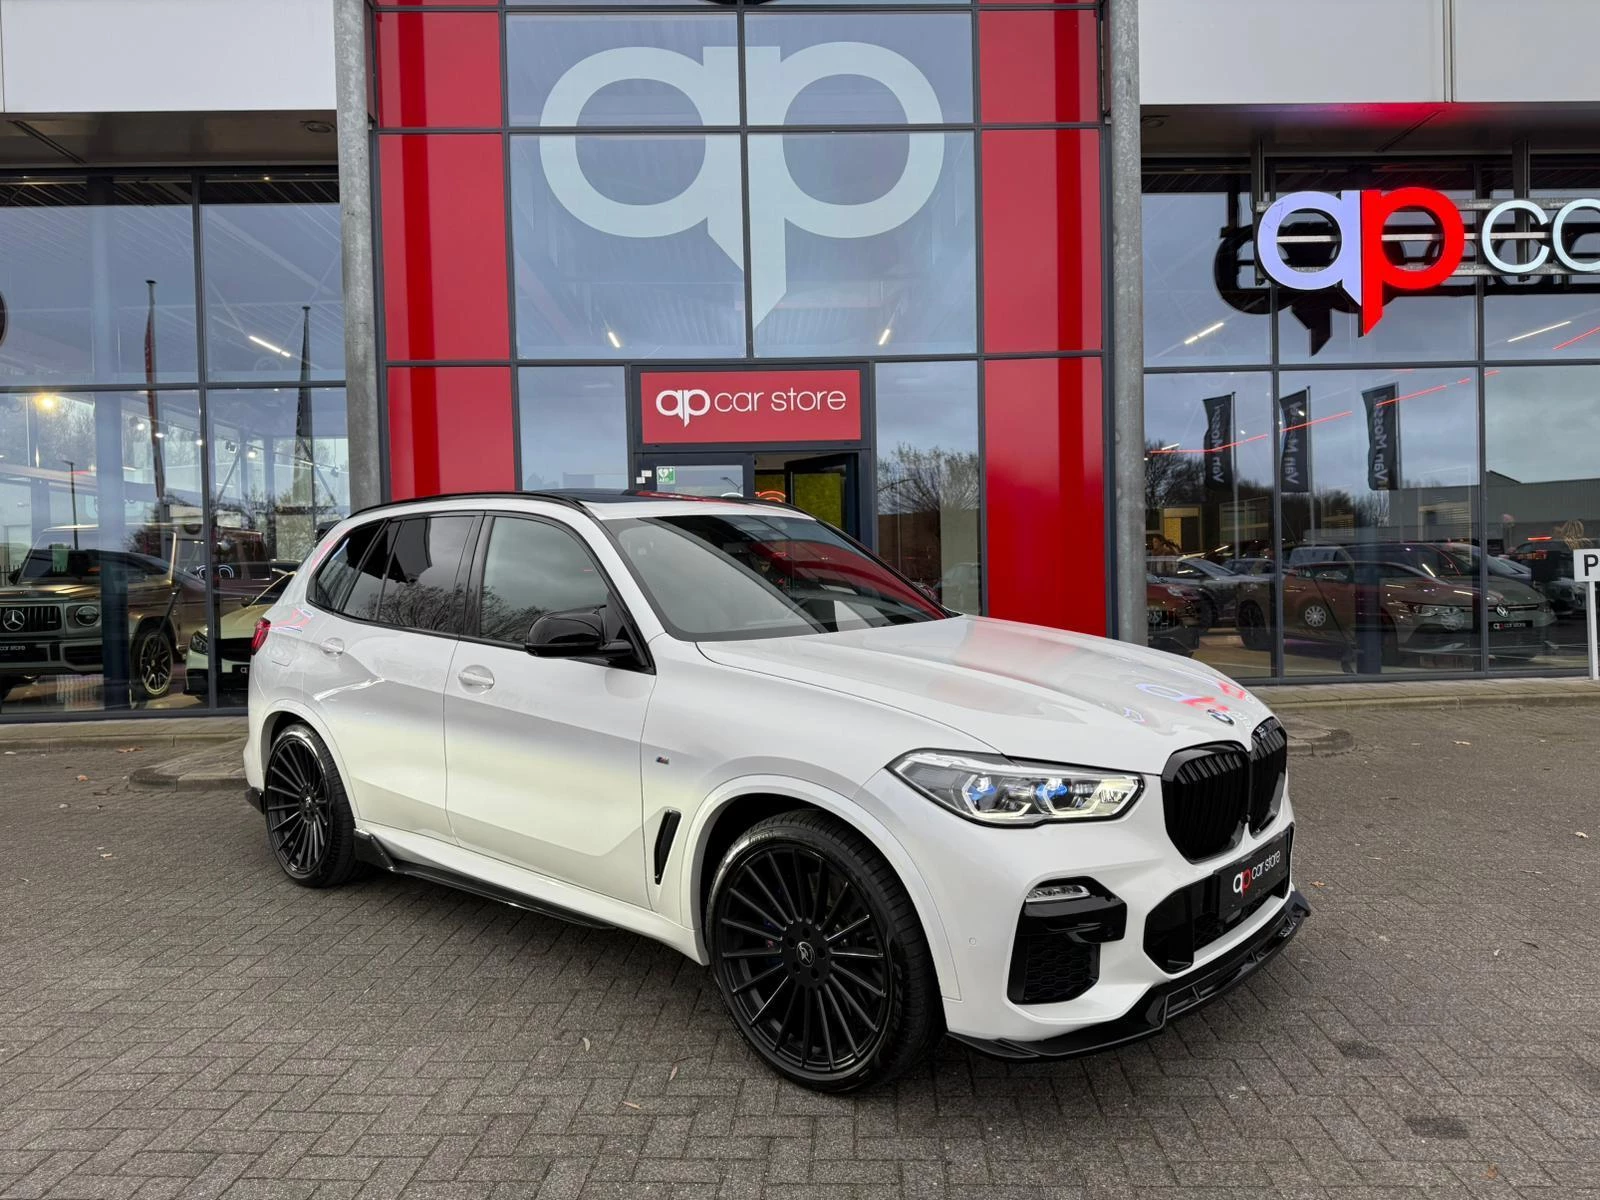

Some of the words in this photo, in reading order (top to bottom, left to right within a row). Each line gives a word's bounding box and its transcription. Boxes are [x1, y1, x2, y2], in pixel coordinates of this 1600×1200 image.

[1257, 186, 1465, 336] ap
[655, 388, 711, 428] ap
[714, 391, 765, 413] car
[770, 387, 847, 412] store
[1251, 861, 1264, 880] car
[1264, 850, 1281, 872] store
